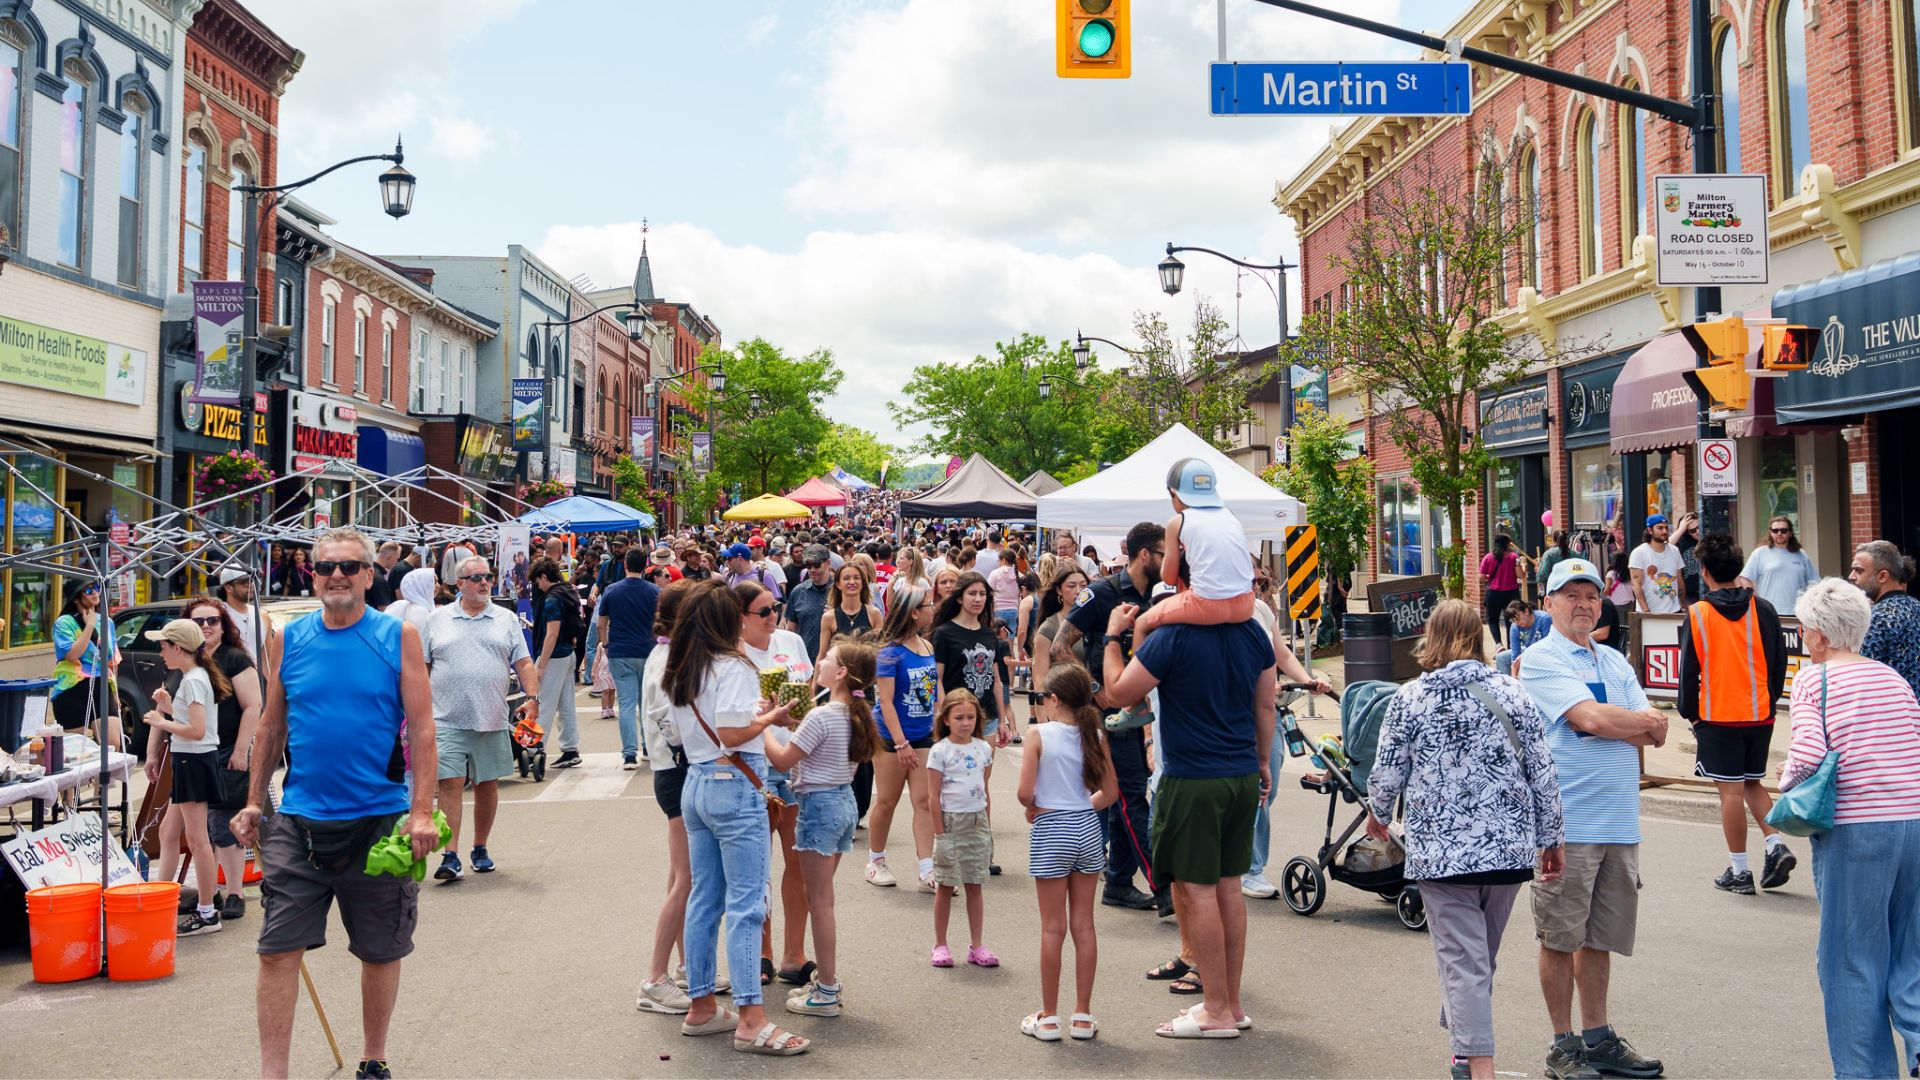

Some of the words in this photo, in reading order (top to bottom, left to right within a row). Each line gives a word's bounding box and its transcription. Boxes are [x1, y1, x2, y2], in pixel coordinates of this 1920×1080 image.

[1263, 73, 1387, 106] Martin
[1396, 73, 1418, 90] St
[1688, 202, 1734, 213] Farmers
[1688, 210, 1726, 218] Market
[1671, 234, 1704, 243] ROAD
[1707, 234, 1754, 243] CLOSED
[195, 287, 244, 295] EXPLORE
[197, 303, 244, 312] MILTON
[0, 321, 34, 351] Milton
[37, 330, 72, 358] Health
[75, 340, 105, 366] Foods
[1862, 321, 1890, 350] THE
[296, 424, 327, 455] HAKKA
[328, 431, 357, 459] HOUSE
[1391, 596, 1425, 623] HALF
[10, 838, 44, 873] Eat
[35, 837, 73, 868] My
